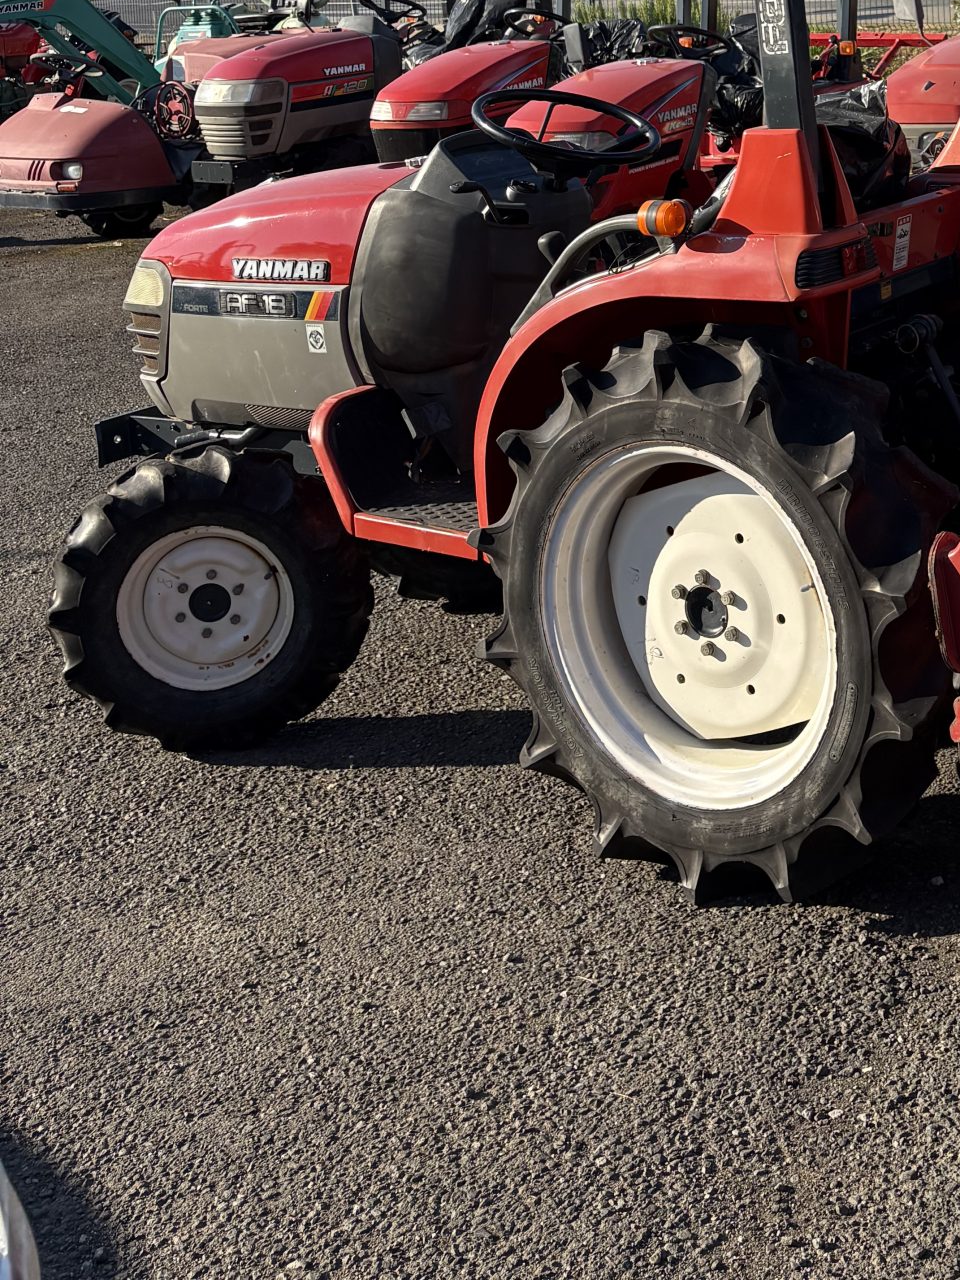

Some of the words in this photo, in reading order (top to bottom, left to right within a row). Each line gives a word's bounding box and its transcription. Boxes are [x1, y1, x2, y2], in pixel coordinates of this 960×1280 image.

[0, 1, 44, 13] YANMAR
[324, 63, 366, 76] YANMAR
[658, 104, 698, 123] YANMAR
[232, 259, 329, 281] YANMAR
